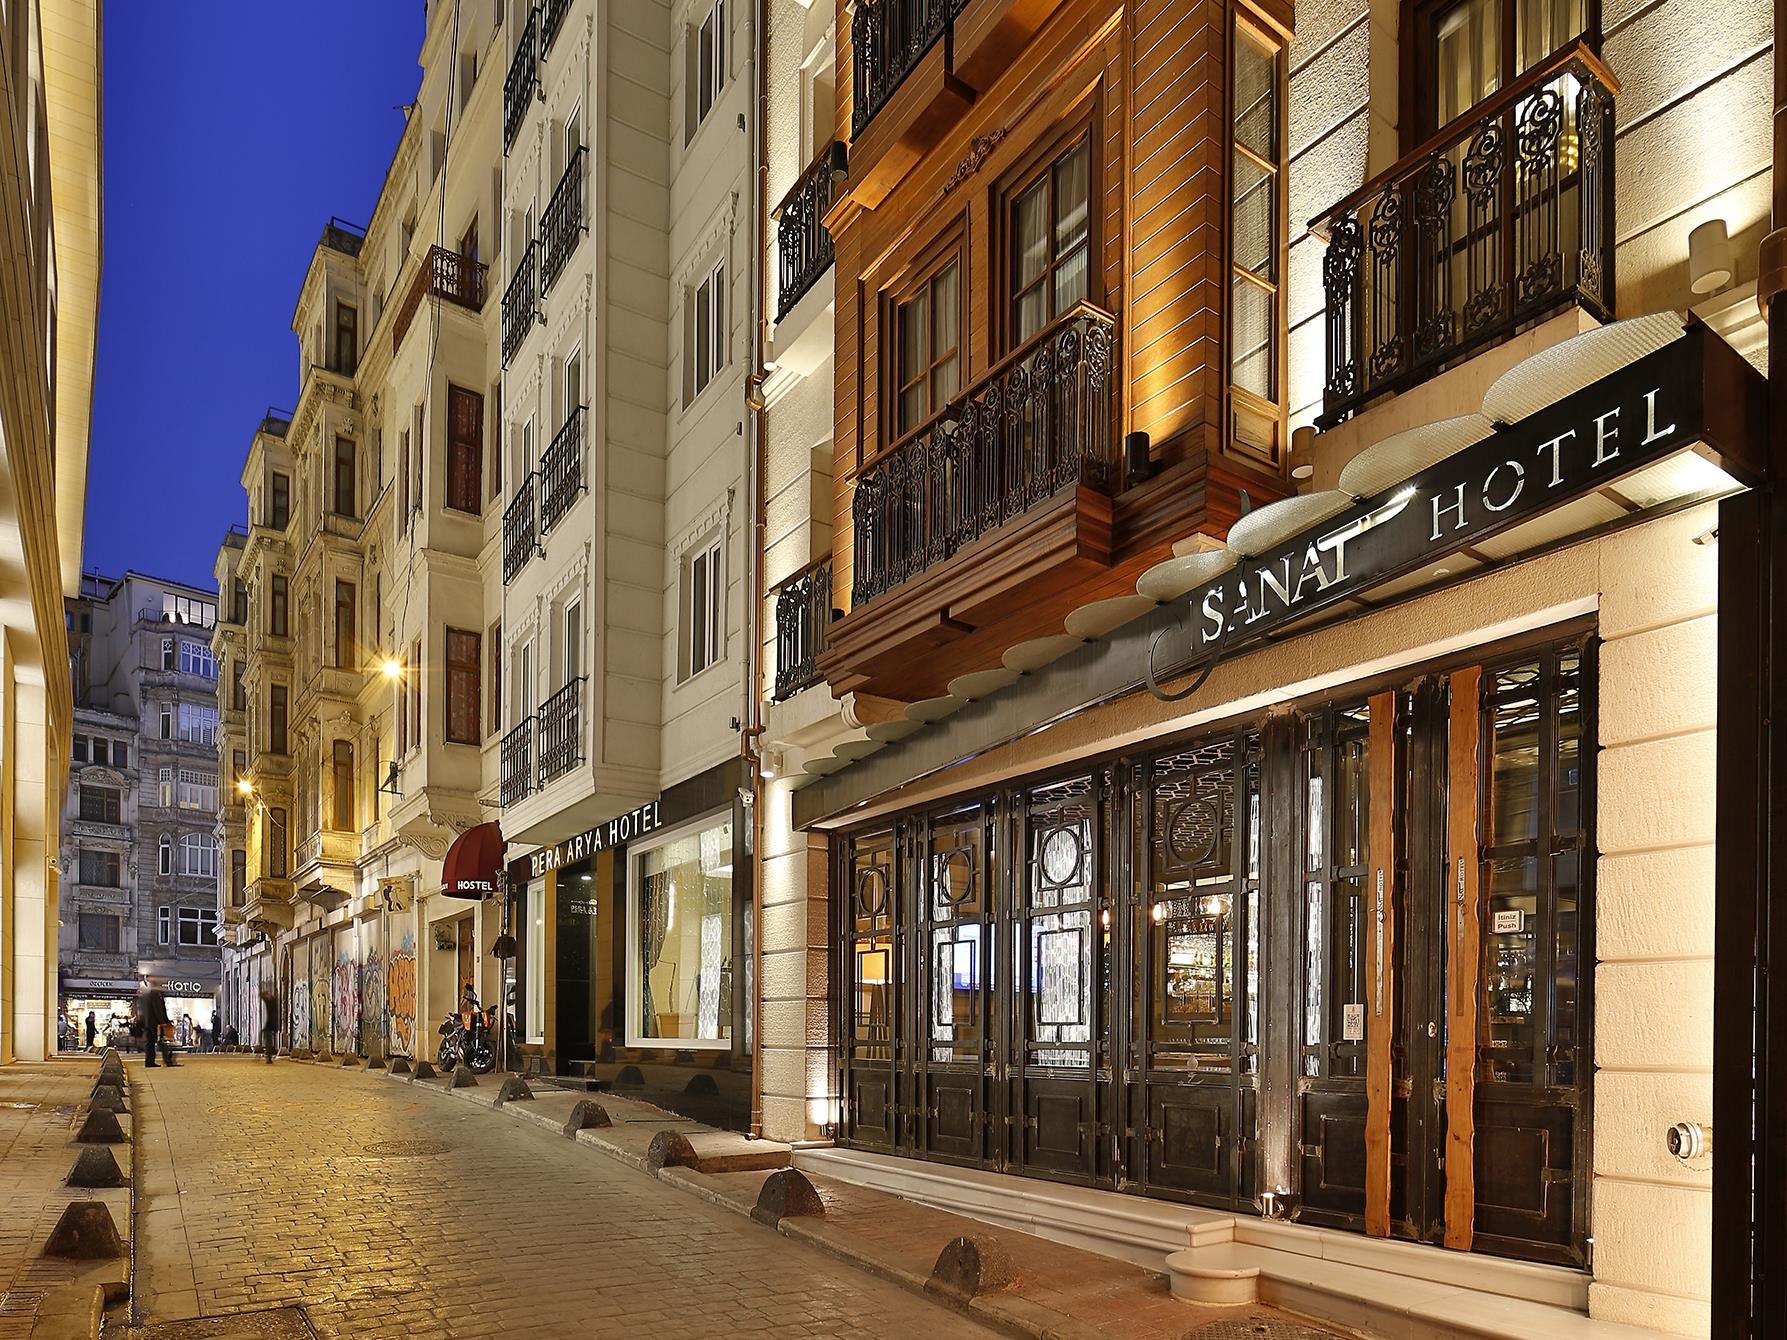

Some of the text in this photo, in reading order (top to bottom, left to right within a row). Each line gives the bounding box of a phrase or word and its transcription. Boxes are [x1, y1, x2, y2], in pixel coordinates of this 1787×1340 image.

[1201, 388, 1676, 644] SANAT HOTEL
[609, 801, 662, 845] HOTEL
[457, 880, 493, 891] HOSTEL
